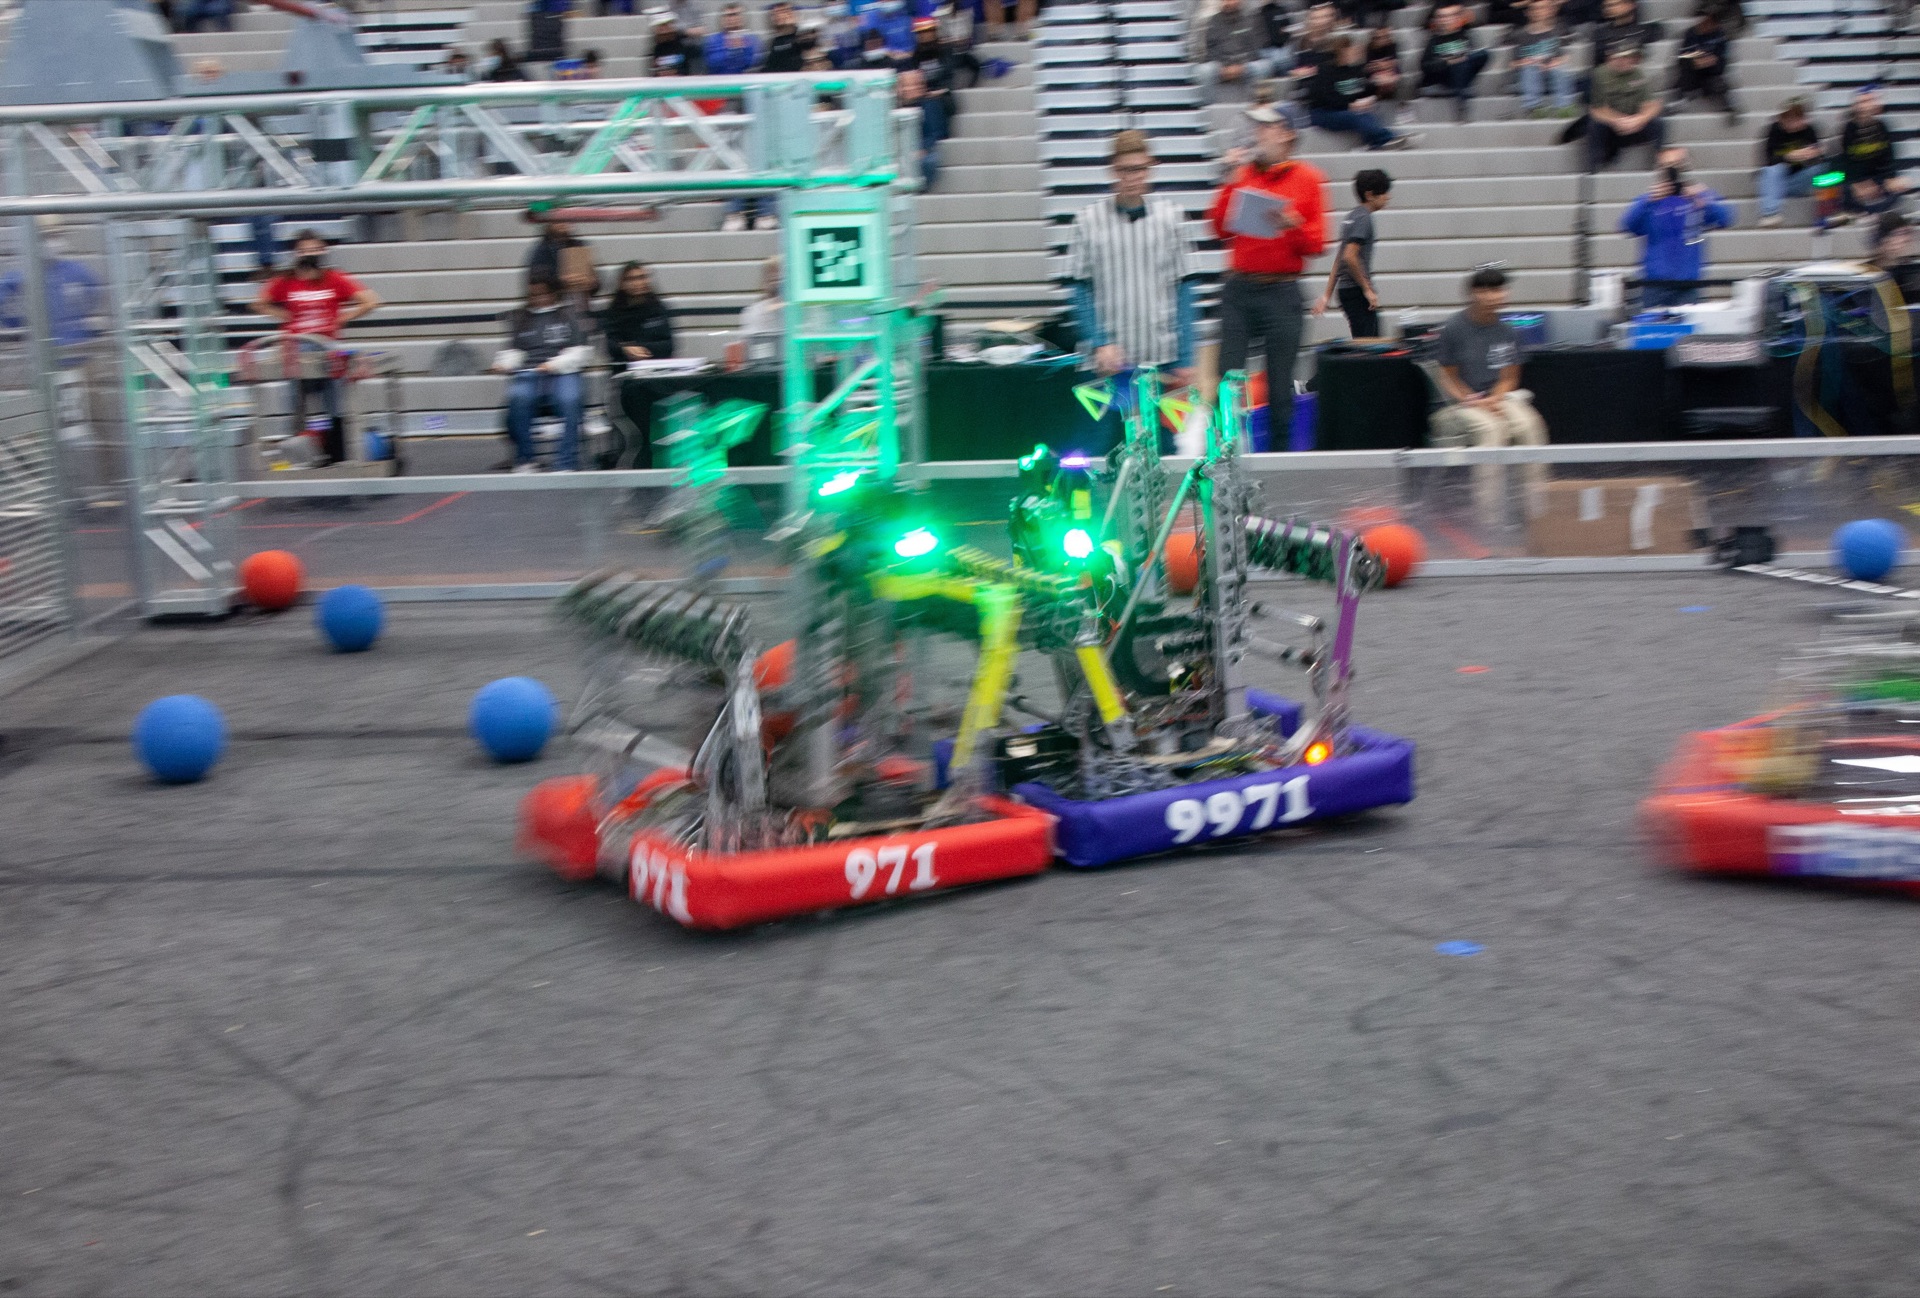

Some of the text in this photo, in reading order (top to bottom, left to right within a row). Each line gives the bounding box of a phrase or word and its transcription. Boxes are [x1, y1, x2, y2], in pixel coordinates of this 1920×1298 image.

[1164, 774, 1316, 844] 9971
[631, 840, 693, 924] 971
[844, 841, 938, 899] 971
